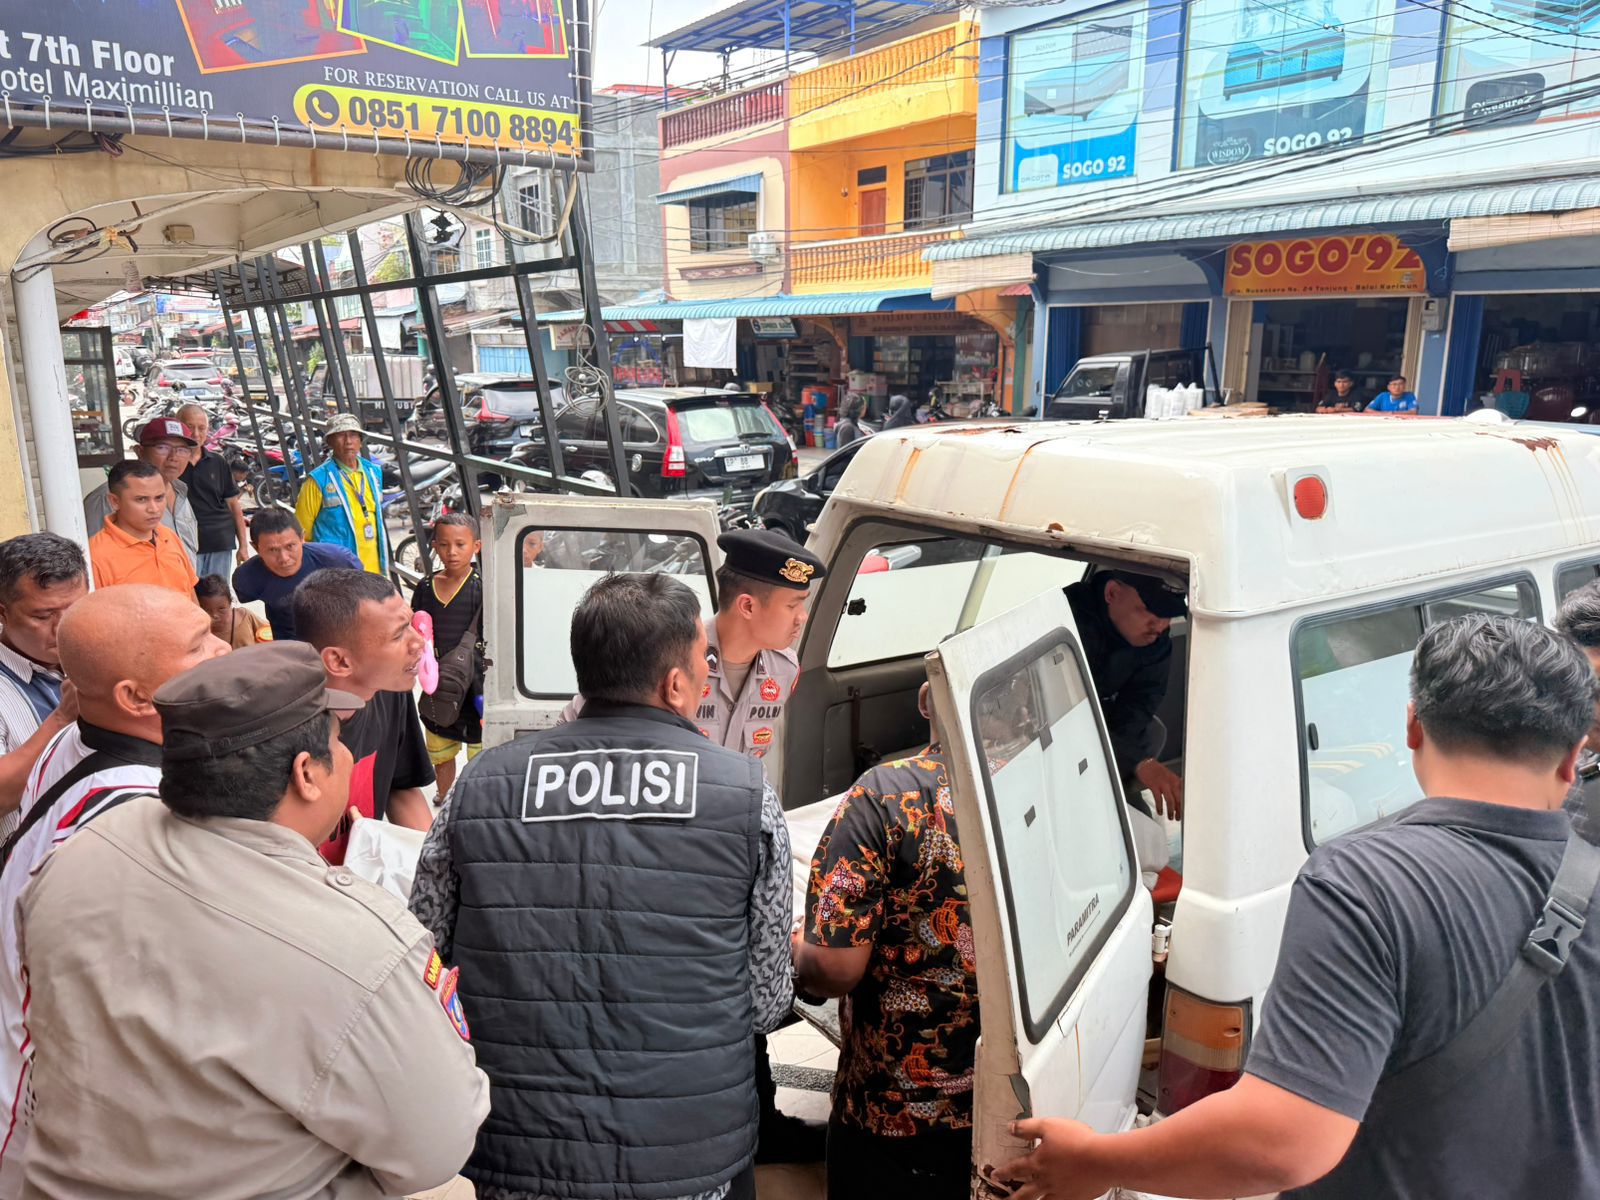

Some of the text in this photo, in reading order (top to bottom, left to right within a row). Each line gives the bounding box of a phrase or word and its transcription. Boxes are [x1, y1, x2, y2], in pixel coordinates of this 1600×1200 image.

[22, 32, 80, 66] 7th
[92, 39, 175, 77] Floor
[64, 70, 214, 110] Maximillian
[323, 65, 570, 110] FOR RESERVATION CALL US AT
[349, 96, 573, 146] 0851 7100 8894
[1211, 147, 1245, 159] WISDOM
[1263, 131, 1322, 156] SOGO
[1062, 155, 1126, 178] SOGO 92
[1230, 235, 1422, 276] SOGO'92
[749, 705, 782, 719] POLRI
[534, 760, 686, 810] POLISI
